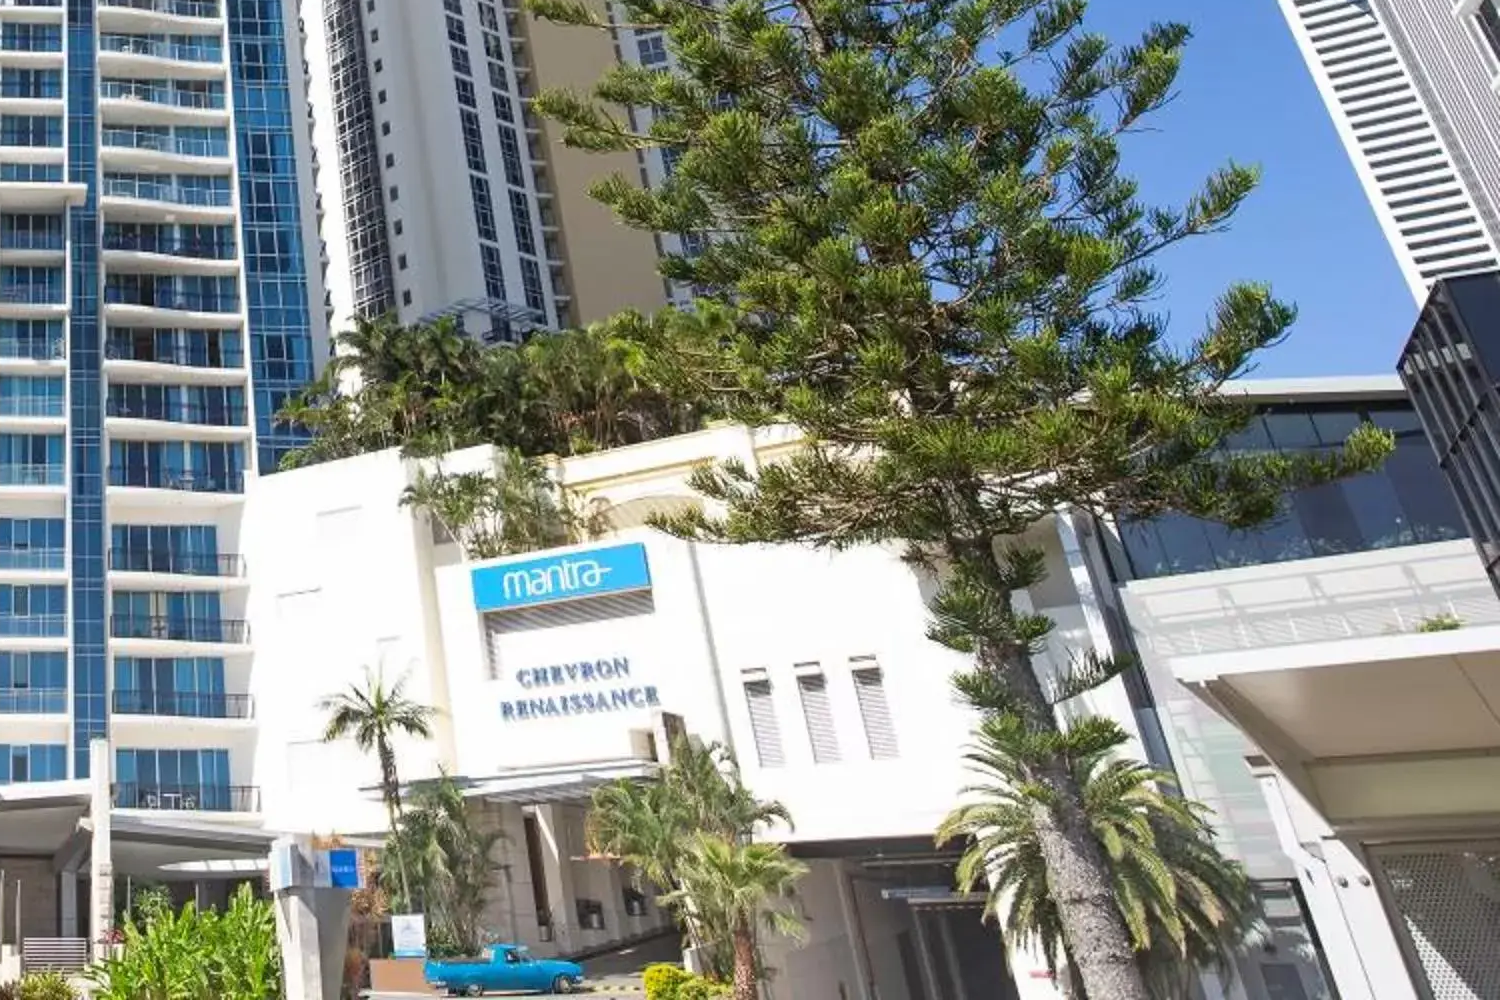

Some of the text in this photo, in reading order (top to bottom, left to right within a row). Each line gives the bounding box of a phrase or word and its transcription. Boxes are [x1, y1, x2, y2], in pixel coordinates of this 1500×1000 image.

[503, 560, 613, 600] mantra
[516, 656, 630, 690] CHEVRON
[501, 686, 661, 722] RENAISSANCE
